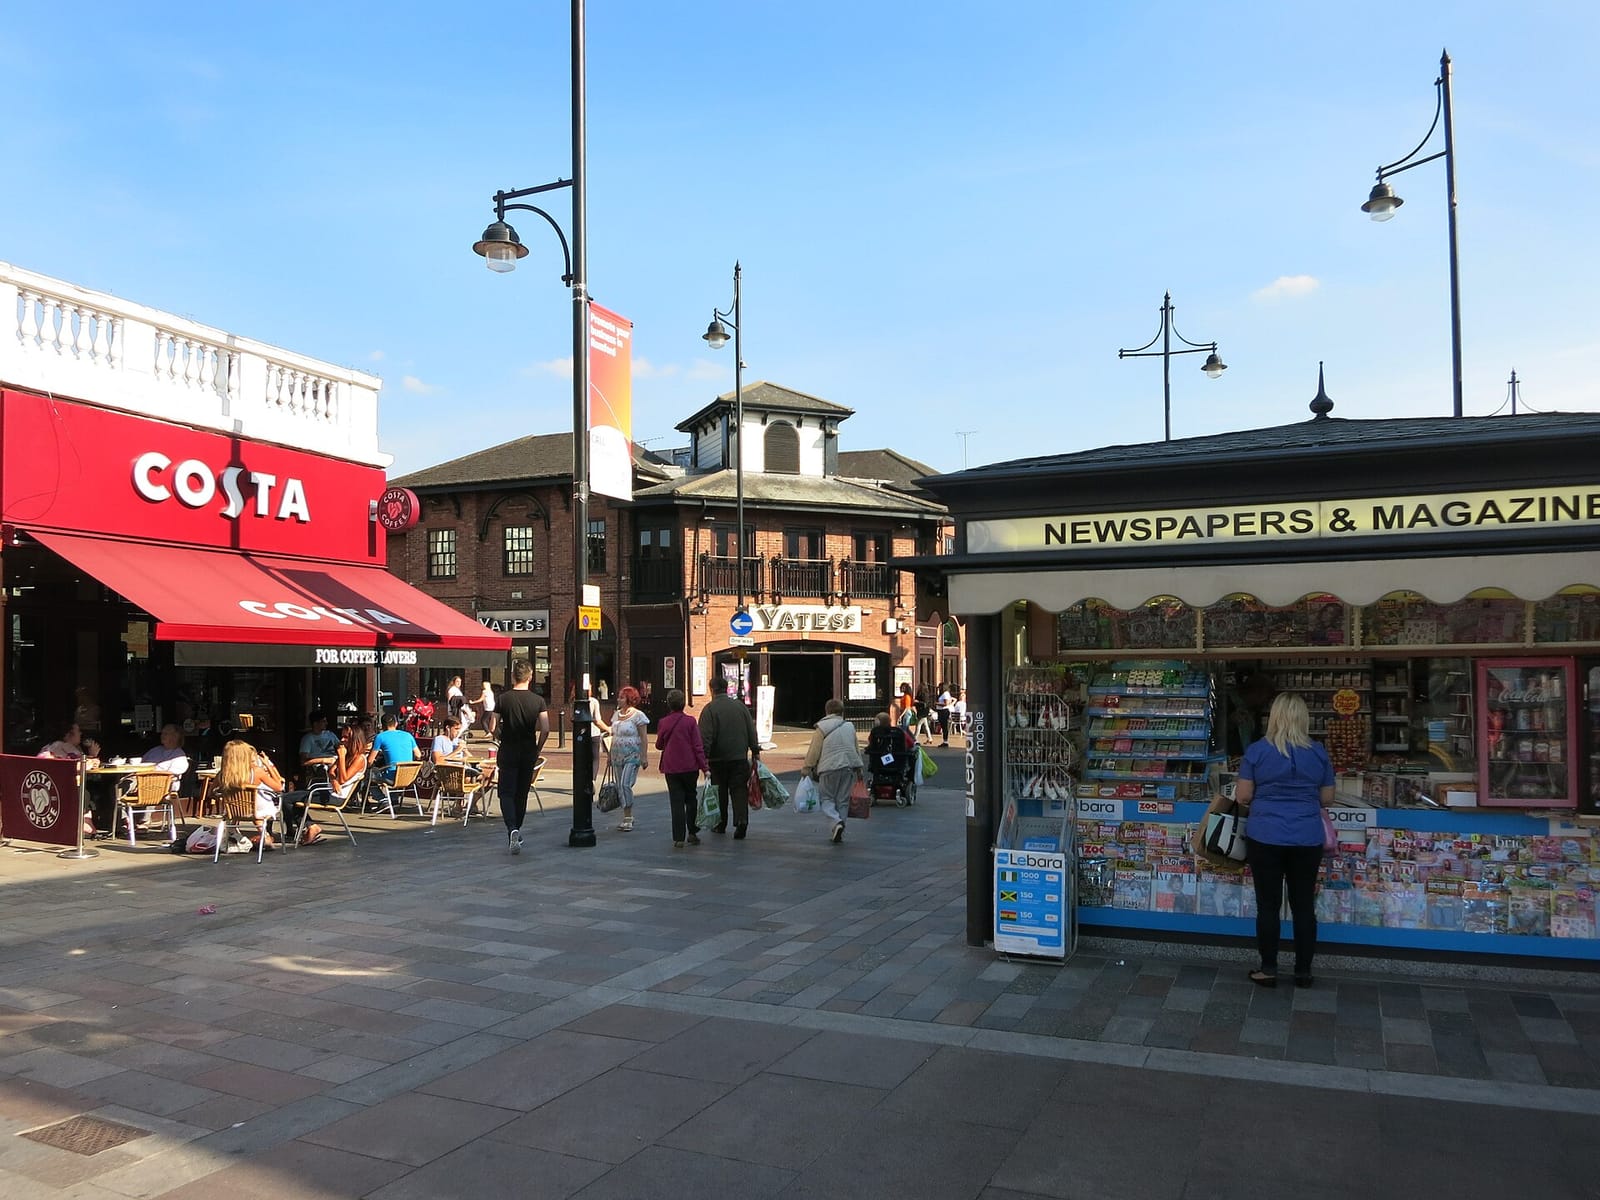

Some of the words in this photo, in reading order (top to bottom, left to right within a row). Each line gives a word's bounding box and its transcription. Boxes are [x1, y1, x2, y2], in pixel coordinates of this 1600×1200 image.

[131, 451, 311, 523] COSTA
[383, 491, 405, 503] COSTA
[381, 513, 407, 527] COFFEE
[1043, 507, 1314, 546] NEWSPAPERS
[1328, 506, 1357, 533] &
[1372, 493, 1600, 532] MAGAZINE
[238, 600, 410, 626] COSTA
[315, 649, 339, 665] FOR
[340, 650, 378, 665] COFFEE
[379, 651, 417, 666] LOVERS
[974, 711, 985, 752] mobile
[25, 773, 51, 790] COSTA
[25, 804, 58, 827] COFFEE
[1010, 853, 1063, 869] Lebara
[1020, 871, 1040, 880] 1000
[1020, 891, 1034, 899] 150
[1020, 911, 1033, 919] 150
